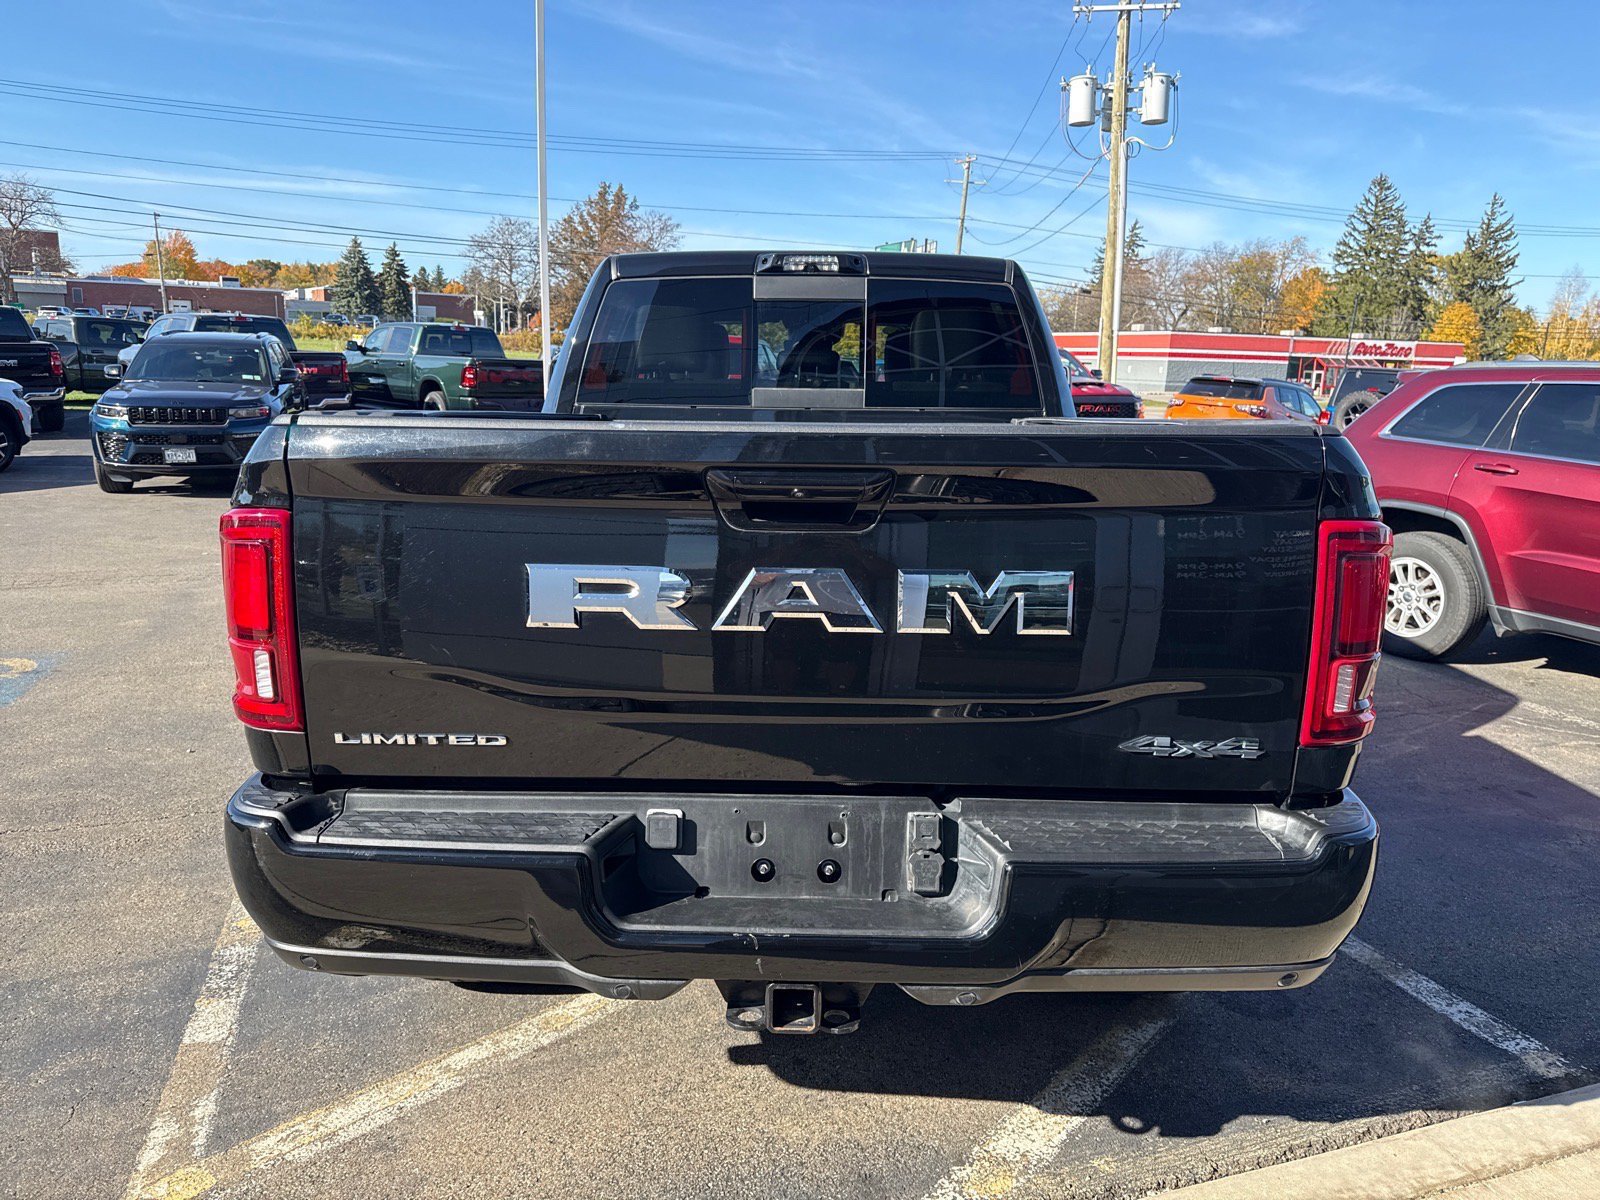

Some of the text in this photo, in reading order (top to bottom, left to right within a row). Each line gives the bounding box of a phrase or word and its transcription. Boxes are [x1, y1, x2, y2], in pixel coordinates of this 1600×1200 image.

[1352, 342, 1413, 357] AutoZone
[524, 563, 1075, 636] RAM
[334, 732, 508, 747] LIMITED
[1118, 735, 1266, 759] 4x4
